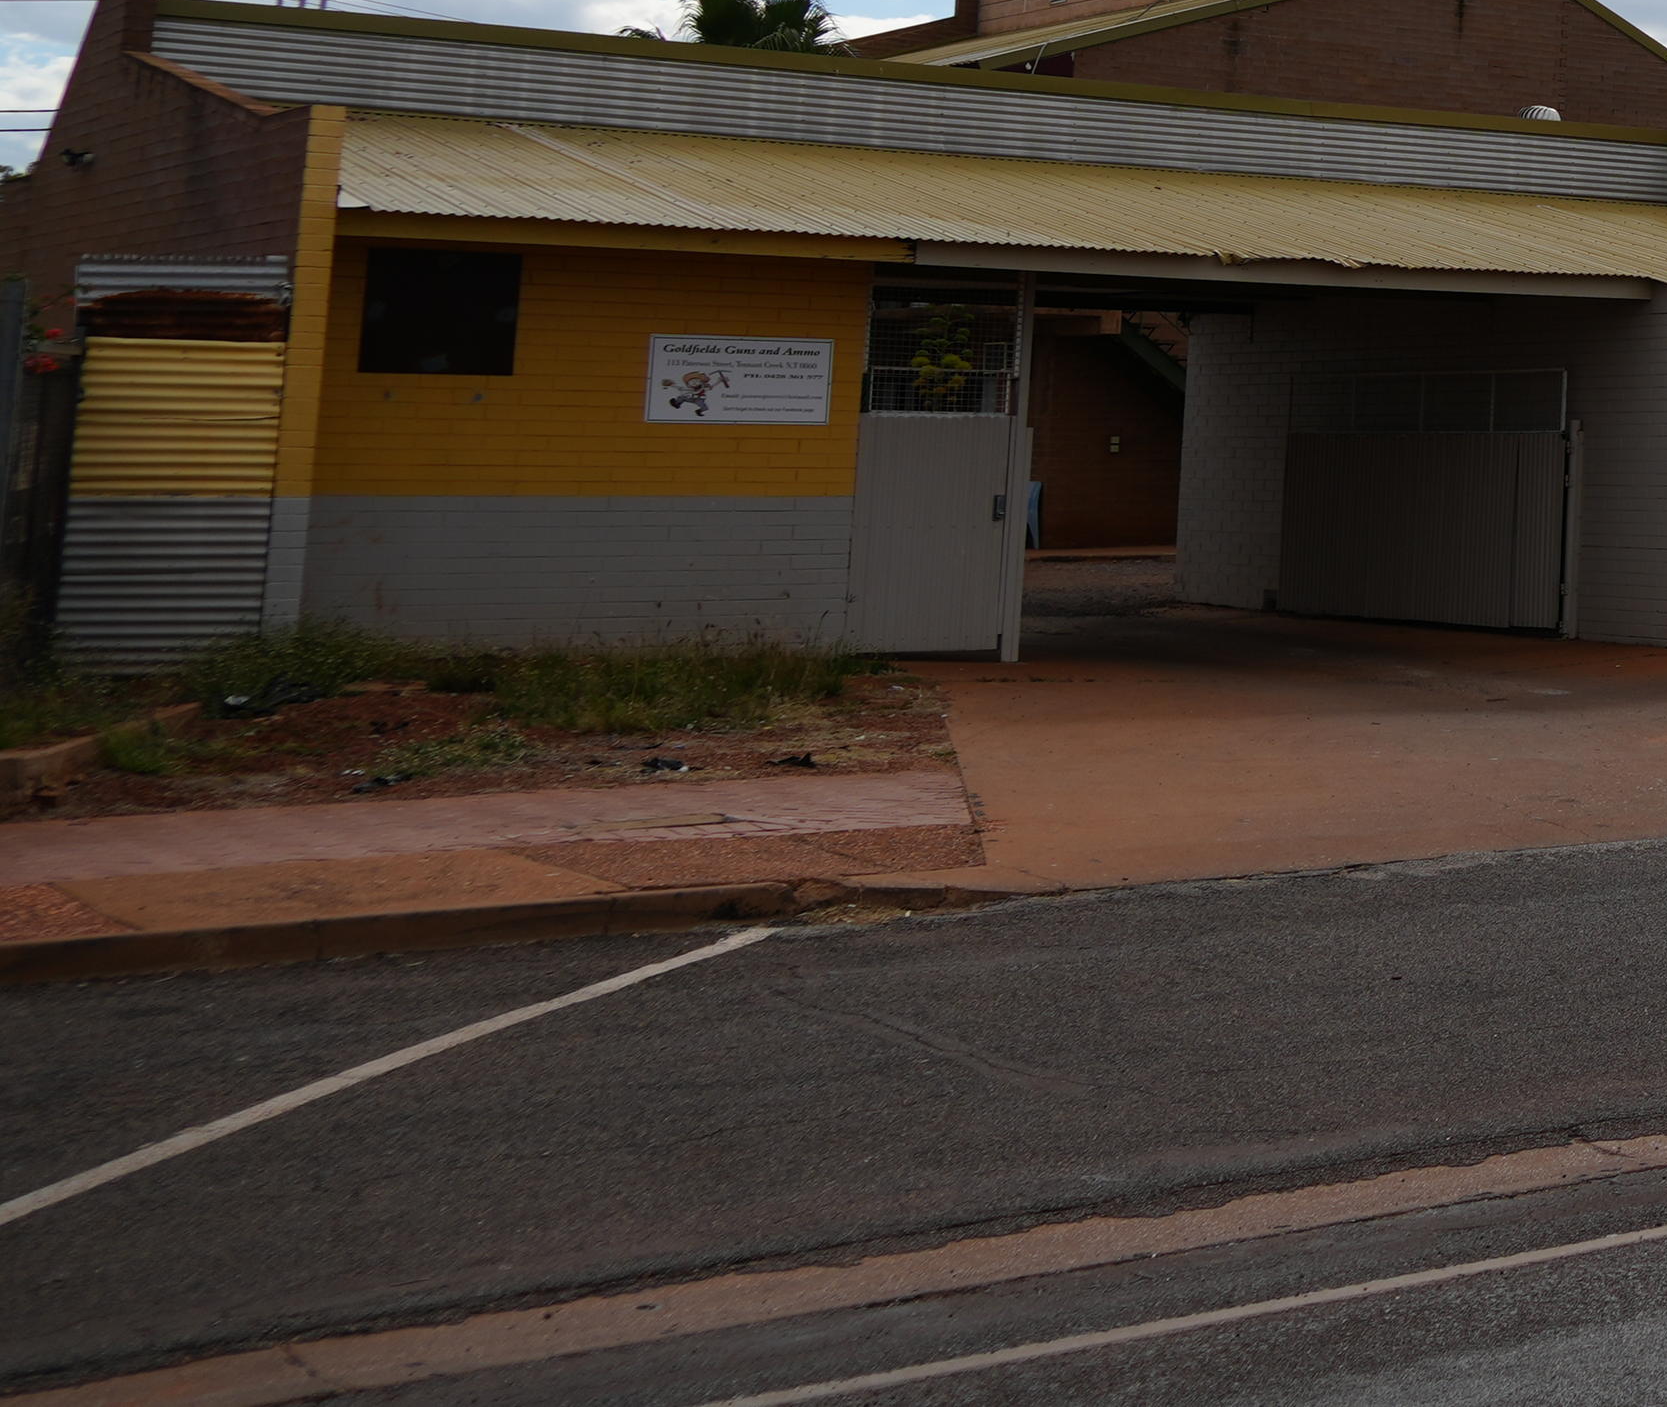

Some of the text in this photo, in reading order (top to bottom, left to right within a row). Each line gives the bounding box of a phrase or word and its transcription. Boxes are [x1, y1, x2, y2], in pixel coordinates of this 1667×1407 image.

[663, 344, 821, 357] Goldfields Guns and Ammo
